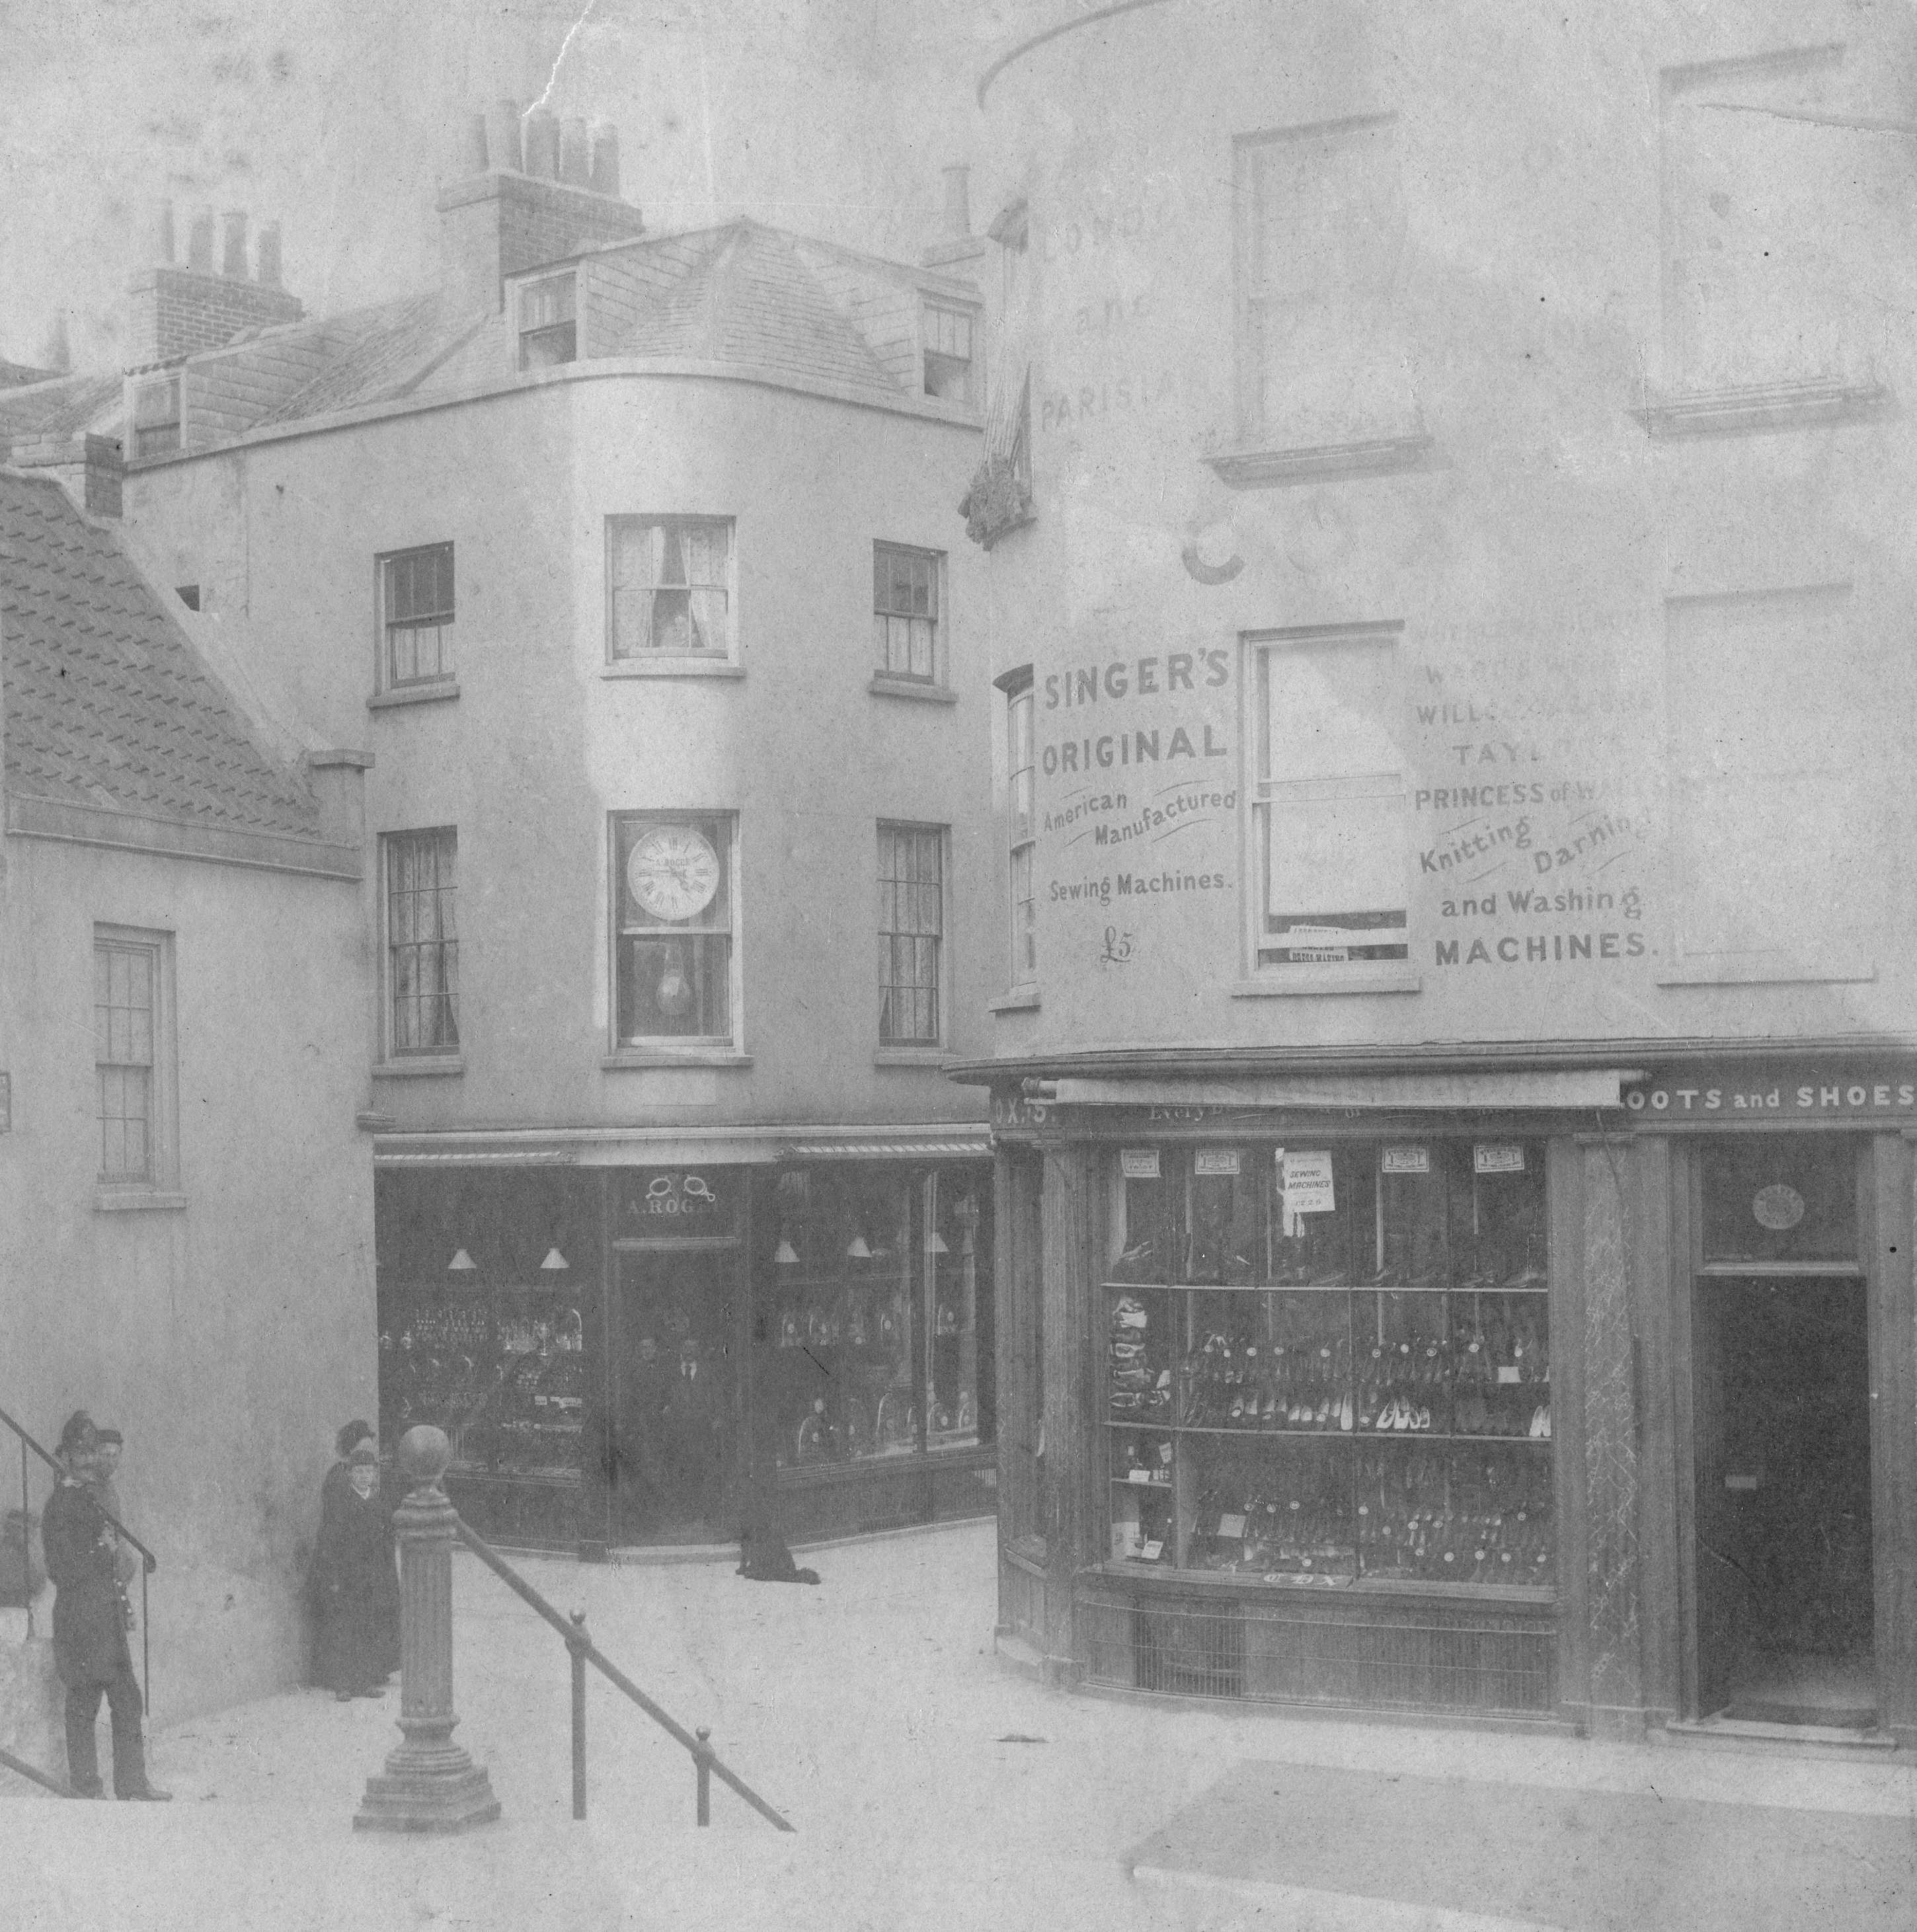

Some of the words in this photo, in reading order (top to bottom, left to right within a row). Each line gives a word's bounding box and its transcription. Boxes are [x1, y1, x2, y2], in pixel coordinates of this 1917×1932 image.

[1044, 648, 1230, 711] SINGER'S
[1042, 725, 1227, 776] ORIGINAL
[1042, 791, 1128, 834] American
[1415, 783, 1544, 810] PRINCESS
[1551, 781, 1571, 802] of
[1095, 790, 1237, 846] Manufactured
[1420, 815, 1534, 874] Knitting
[1050, 878, 1111, 906] Sewing
[1118, 869, 1233, 896] Machines.
[1442, 891, 1497, 917] and
[1507, 884, 1642, 920] Washing
[1100, 925, 1134, 964] £5
[1435, 932, 1659, 966] MACHINES.
[1622, 1089, 1723, 1110] OOTS
[1734, 1088, 1780, 1108] and
[1797, 1085, 1916, 1108] SHOES
[1288, 1180, 1331, 1190] MACHINES
[1290, 1170, 1321, 1179] SEWING
